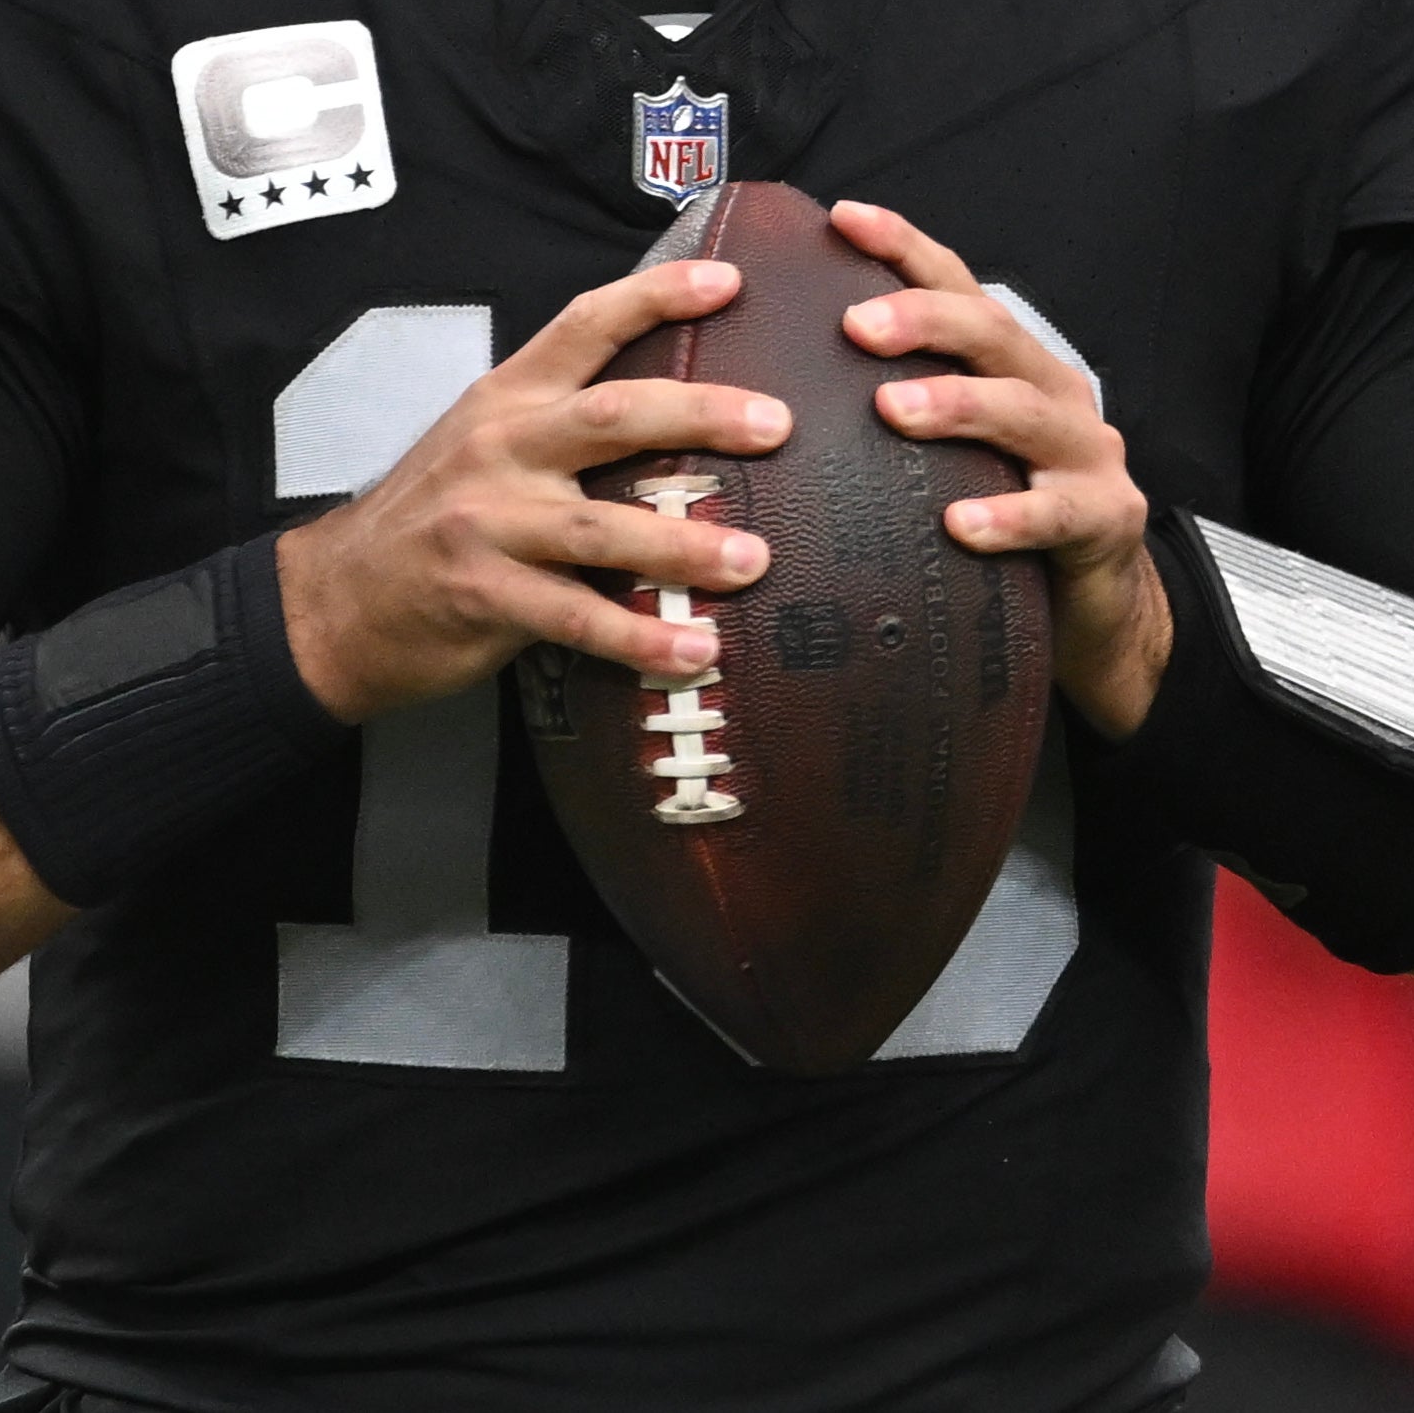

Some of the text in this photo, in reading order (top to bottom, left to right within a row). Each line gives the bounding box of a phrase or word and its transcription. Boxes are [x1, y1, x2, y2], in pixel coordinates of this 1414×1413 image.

[194, 38, 366, 178] C
[649, 139, 713, 186] NFL
[273, 283, 1102, 1071] 1
[919, 516, 950, 698] FOOTBALL
